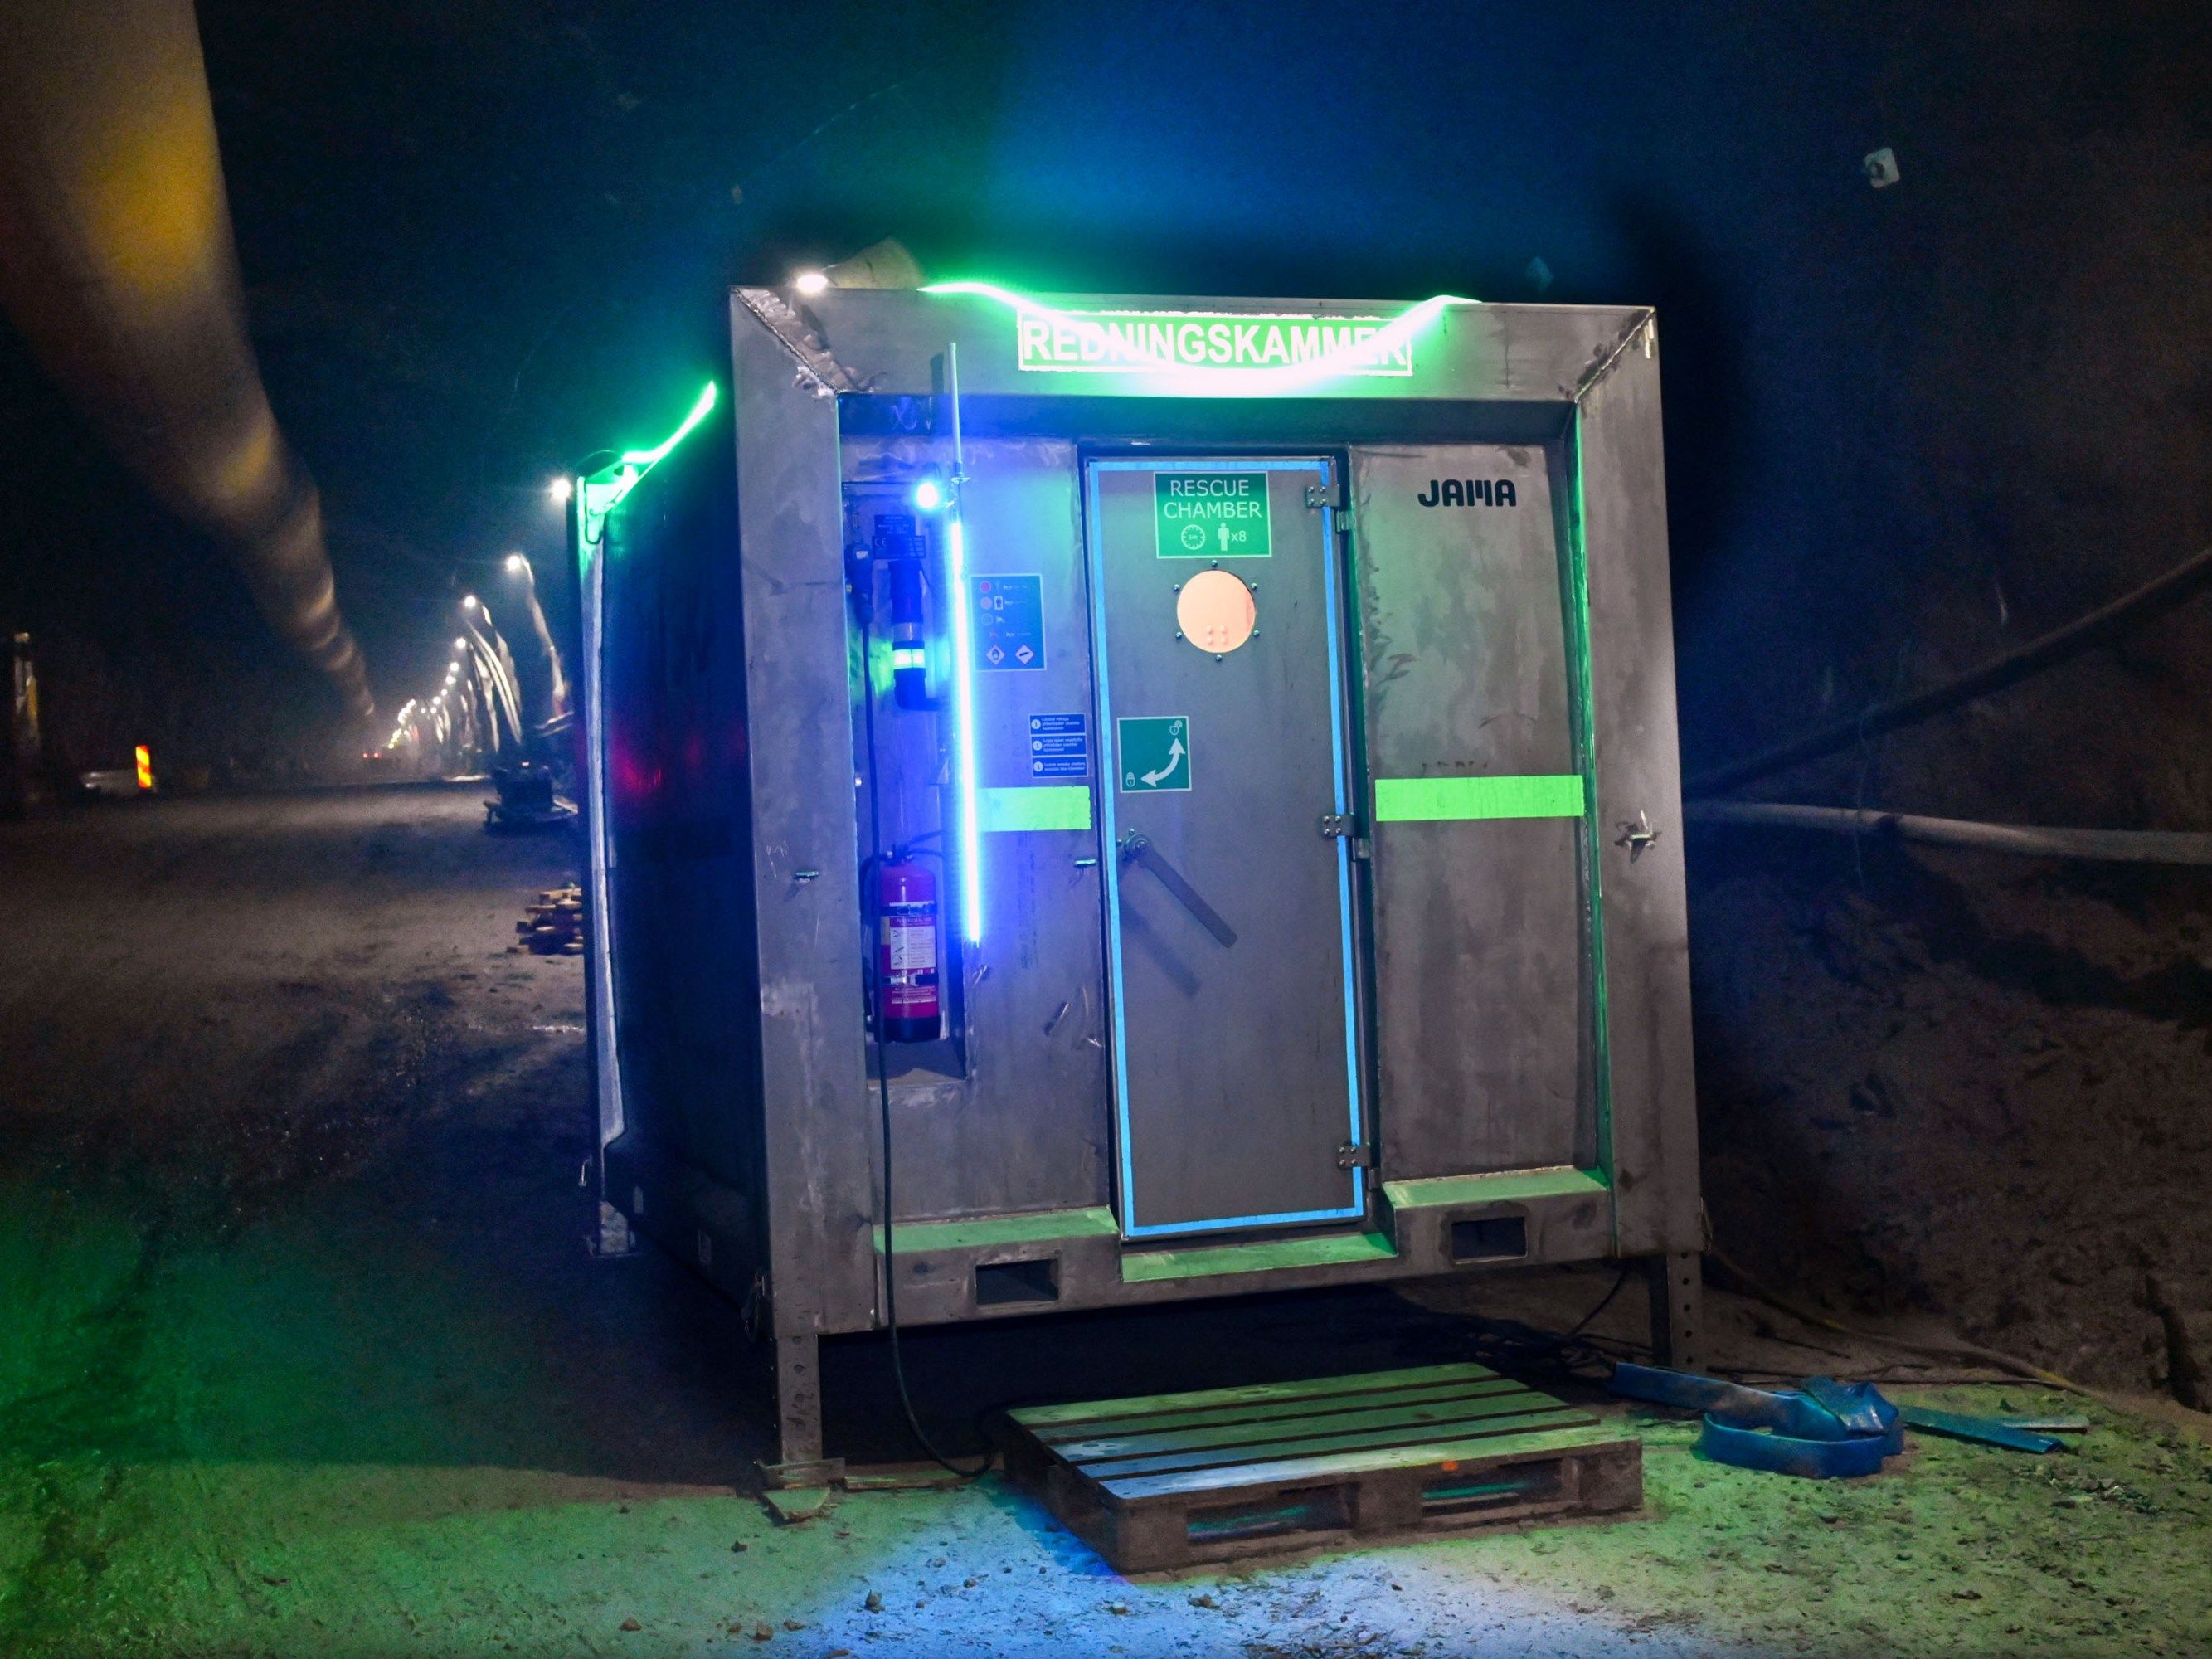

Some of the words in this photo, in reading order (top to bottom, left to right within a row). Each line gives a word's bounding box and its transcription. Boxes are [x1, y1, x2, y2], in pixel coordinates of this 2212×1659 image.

[1170, 479, 1249, 497] RESCUE
[1417, 479, 1517, 507] JAMA
[1164, 501, 1262, 518] CHAMBER
[1231, 530, 1247, 542] x8
